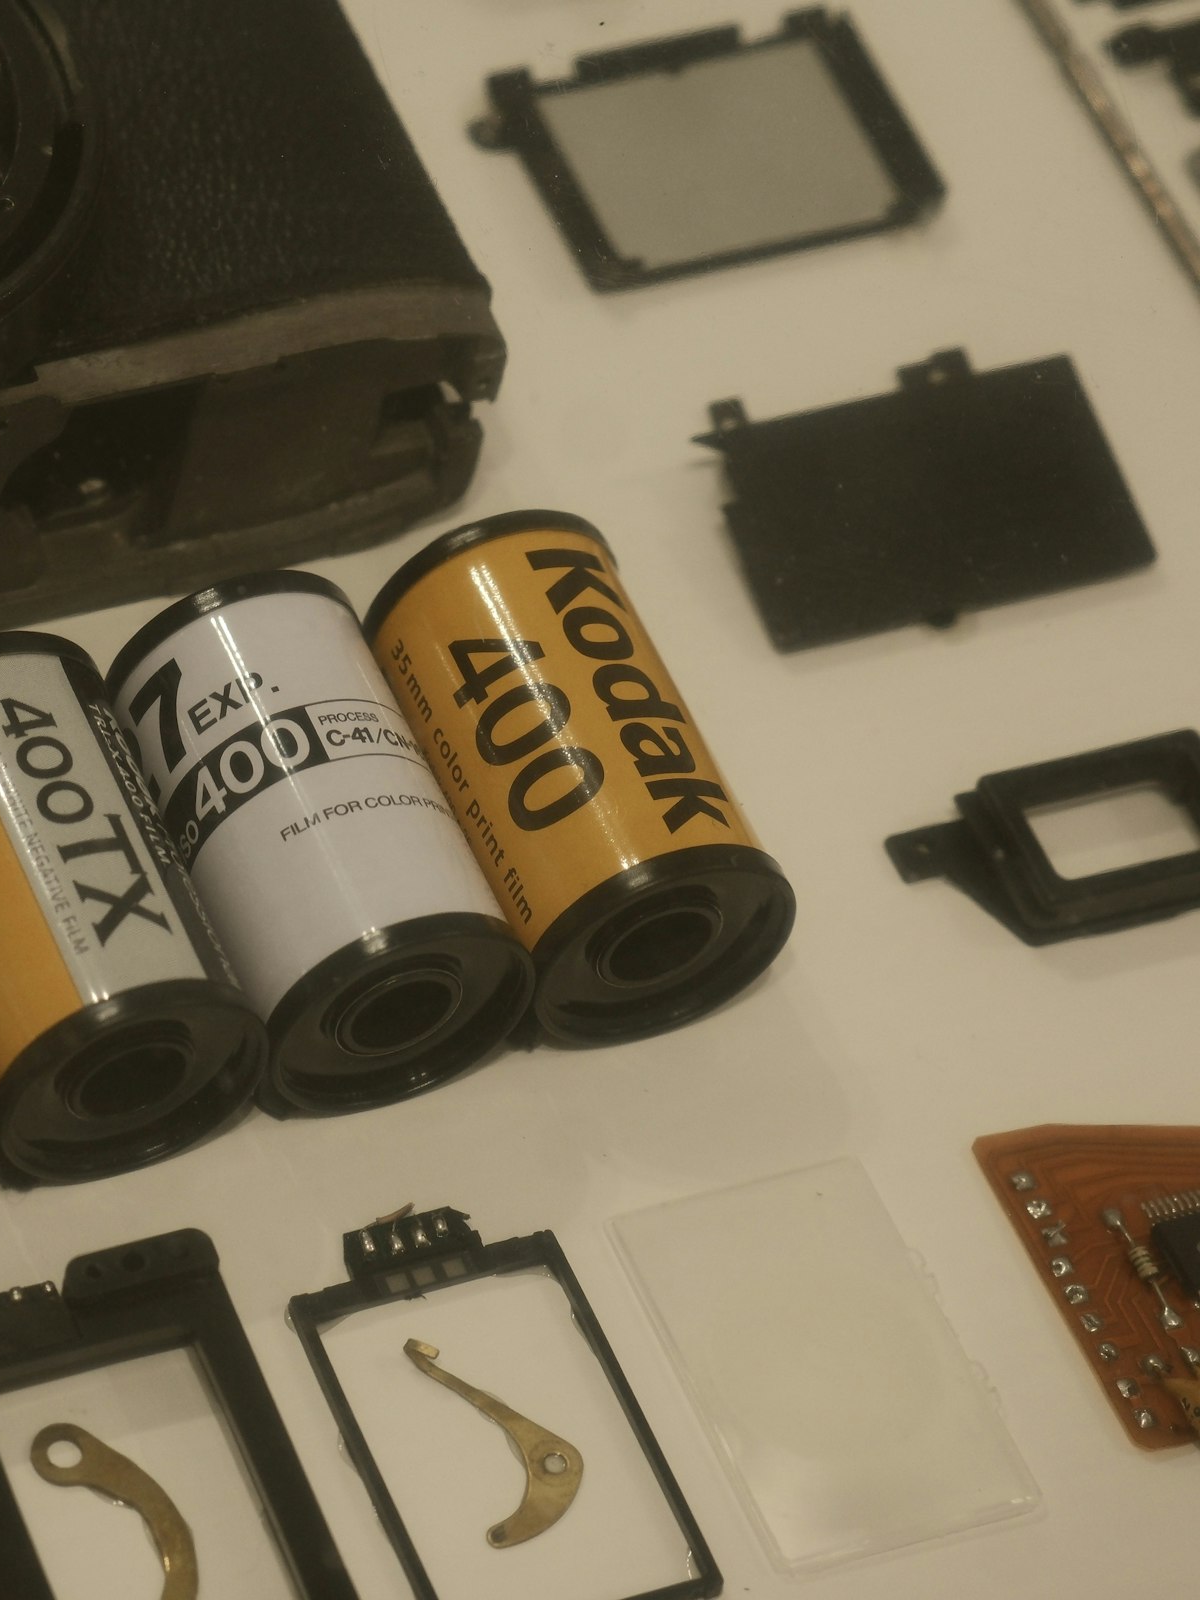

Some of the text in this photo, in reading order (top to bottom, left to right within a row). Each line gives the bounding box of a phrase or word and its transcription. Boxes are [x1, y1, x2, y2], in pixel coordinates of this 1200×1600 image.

[187, 672, 280, 735] EXP.
[318, 712, 379, 726] PROCESS
[447, 638, 605, 831] 400
[525, 548, 731, 834] Kodak
[117, 764, 144, 808] 400
[140, 813, 171, 865] FILM
[195, 718, 310, 816] 400
[279, 812, 321, 842] FILM
[323, 801, 363, 820] FOR
[364, 794, 423, 809] COLOR
[432, 728, 470, 795] color
[466, 799, 505, 868] print
[503, 866, 533, 926] film
[24, 830, 70, 913] NEGATIVE
[61, 914, 90, 956] FILM
